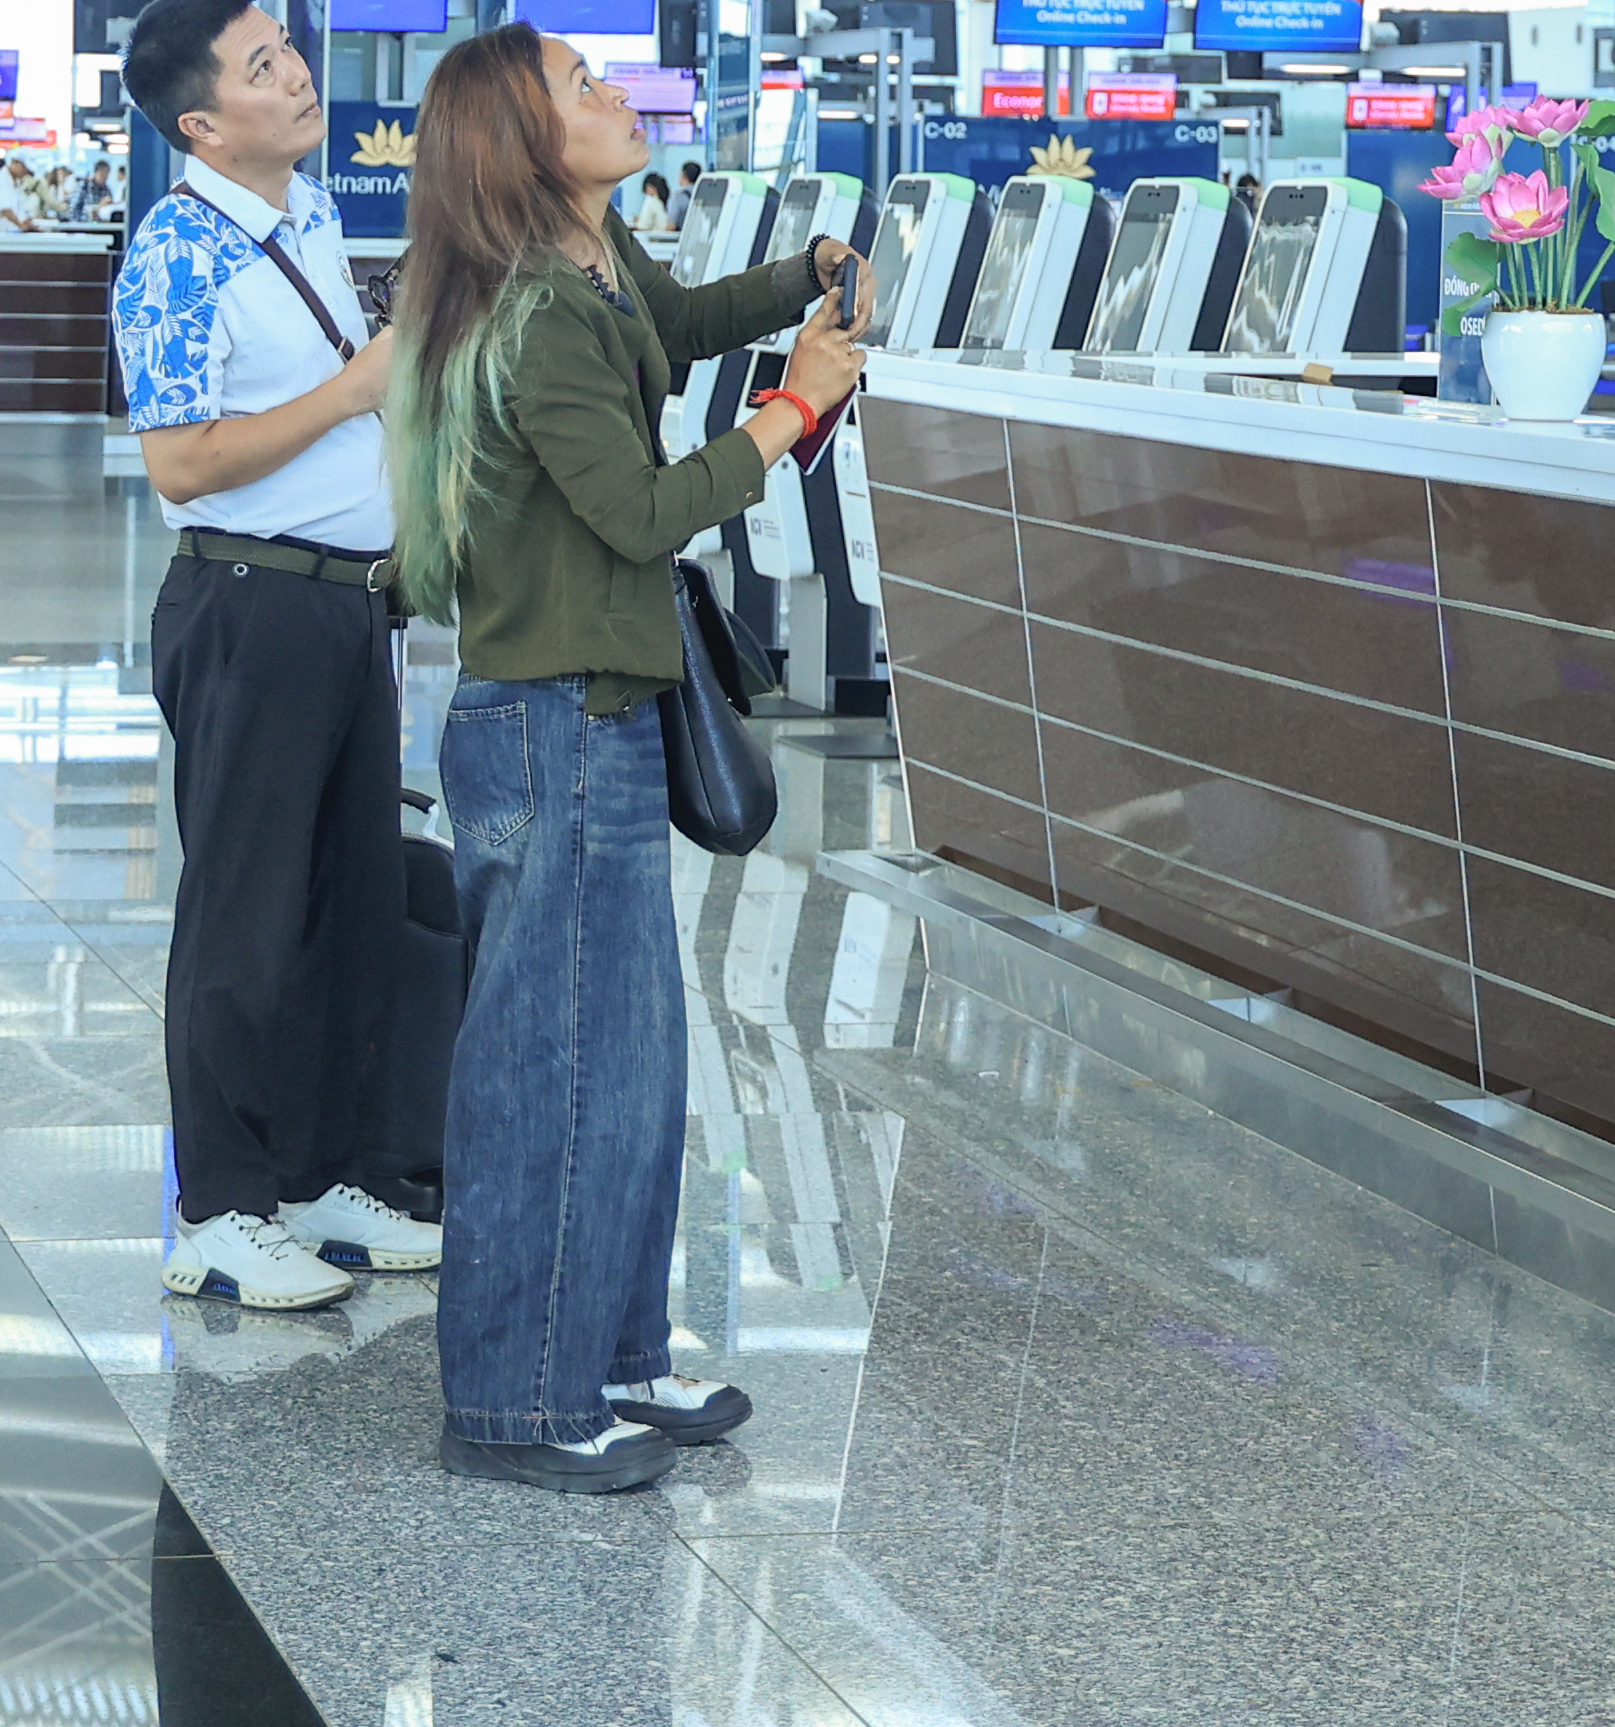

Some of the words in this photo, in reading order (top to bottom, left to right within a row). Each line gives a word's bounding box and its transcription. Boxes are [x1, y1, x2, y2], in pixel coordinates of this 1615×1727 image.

[994, 92, 1043, 109] Econo
[924, 123, 966, 139] C-02
[1175, 125, 1217, 144] C-03
[325, 175, 390, 194] etnam
[1444, 276, 1468, 296] ĐÓNG
[1460, 317, 1486, 335] OSED
